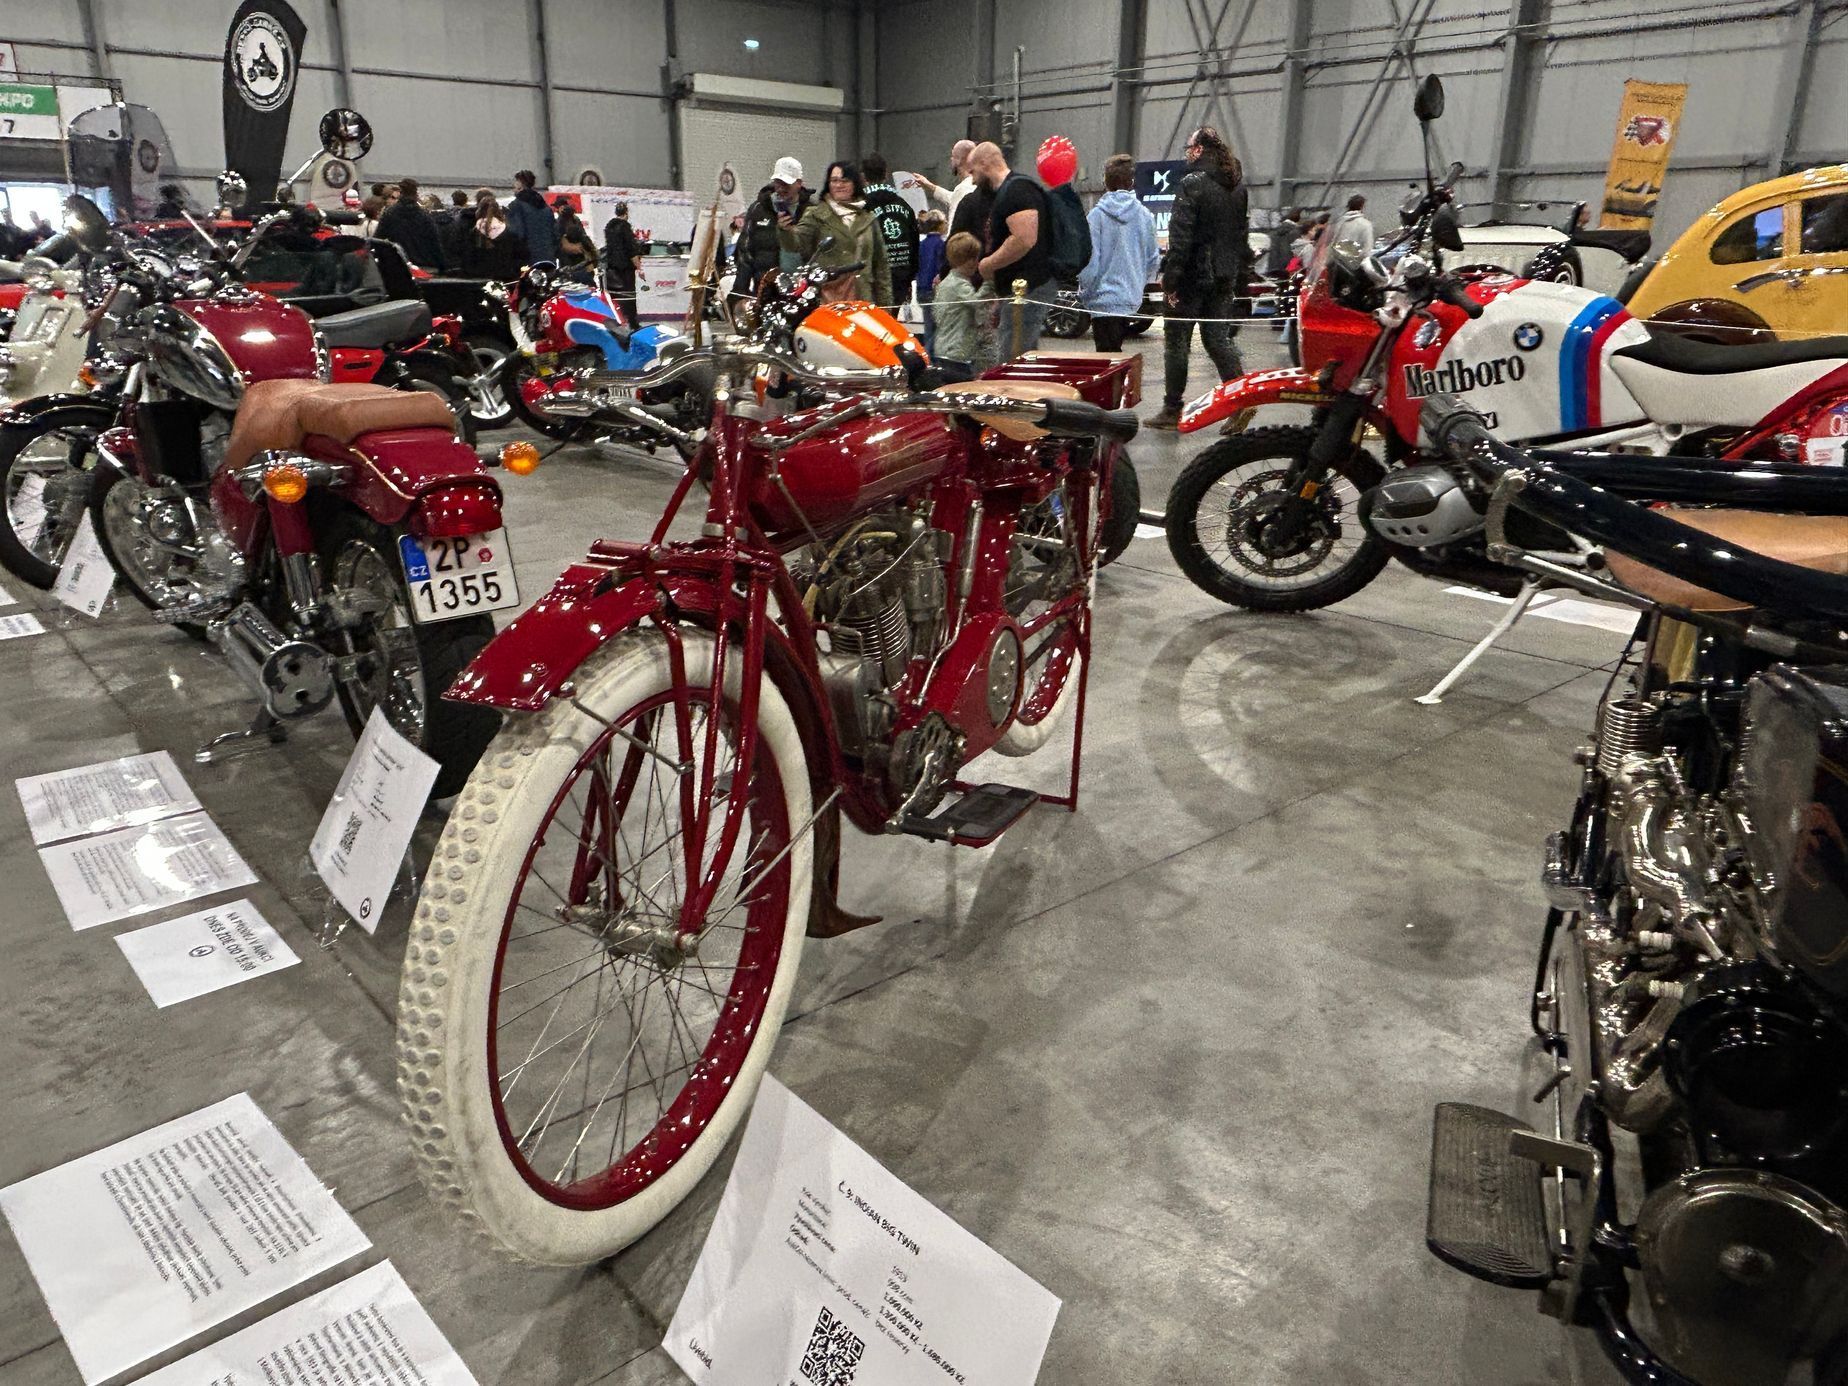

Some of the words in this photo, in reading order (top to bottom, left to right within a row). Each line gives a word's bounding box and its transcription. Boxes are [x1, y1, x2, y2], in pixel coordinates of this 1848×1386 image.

[1404, 355, 1525, 398] Marlboro
[409, 565, 428, 577] CZ
[431, 537, 470, 572] 2P
[420, 571, 502, 613] 1355
[897, 1230, 921, 1256] TWIN
